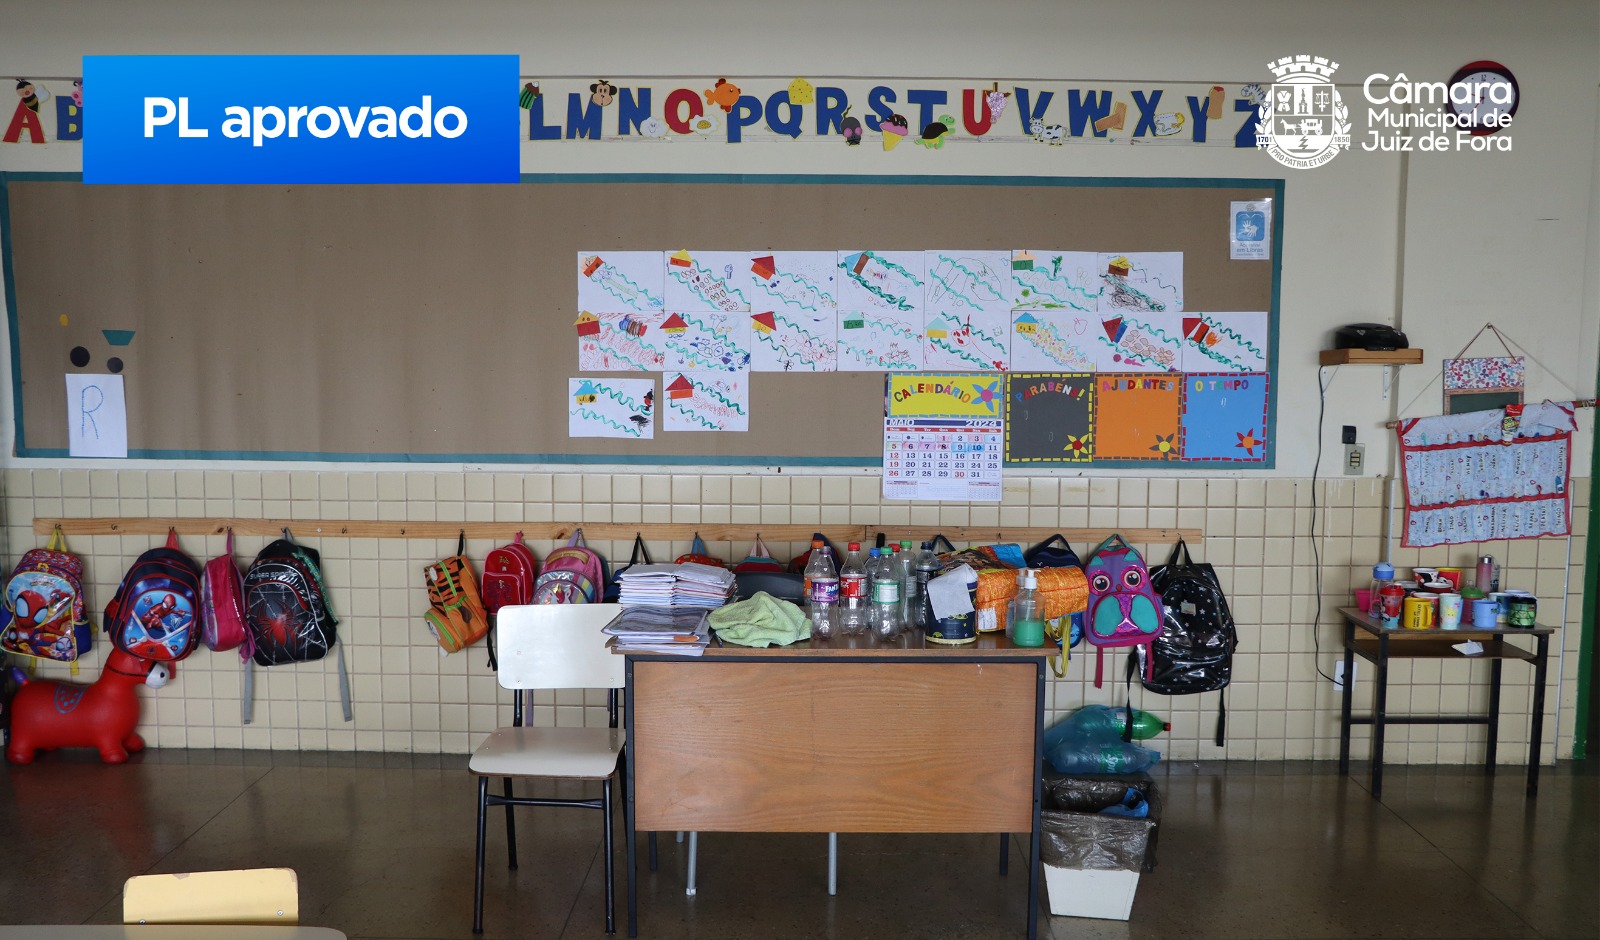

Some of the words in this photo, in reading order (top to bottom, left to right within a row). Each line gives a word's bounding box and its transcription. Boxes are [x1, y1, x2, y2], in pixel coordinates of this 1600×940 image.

[3, 96, 45, 143] A
[530, 93, 561, 140] L
[566, 93, 602, 140] M
[618, 87, 651, 136] N
[664, 89, 704, 134] O
[726, 95, 763, 143] P
[765, 90, 803, 139] Q
[816, 87, 848, 135] R
[865, 86, 897, 132] S
[907, 89, 947, 136] T
[962, 89, 992, 136] U
[1013, 87, 1054, 135] V
[1067, 89, 1113, 137] W
[1130, 90, 1163, 137] X
[1185, 96, 1212, 143] Y
[894, 381, 971, 403] CALENDÁRIO
[1015, 378, 1085, 402] PARABÉNS!
[1103, 379, 1175, 392] AJUDANTES
[1195, 380, 1204, 392] O
[1209, 379, 1249, 391] TEMPO
[81, 385, 104, 439] R
[965, 420, 997, 428] 2024
